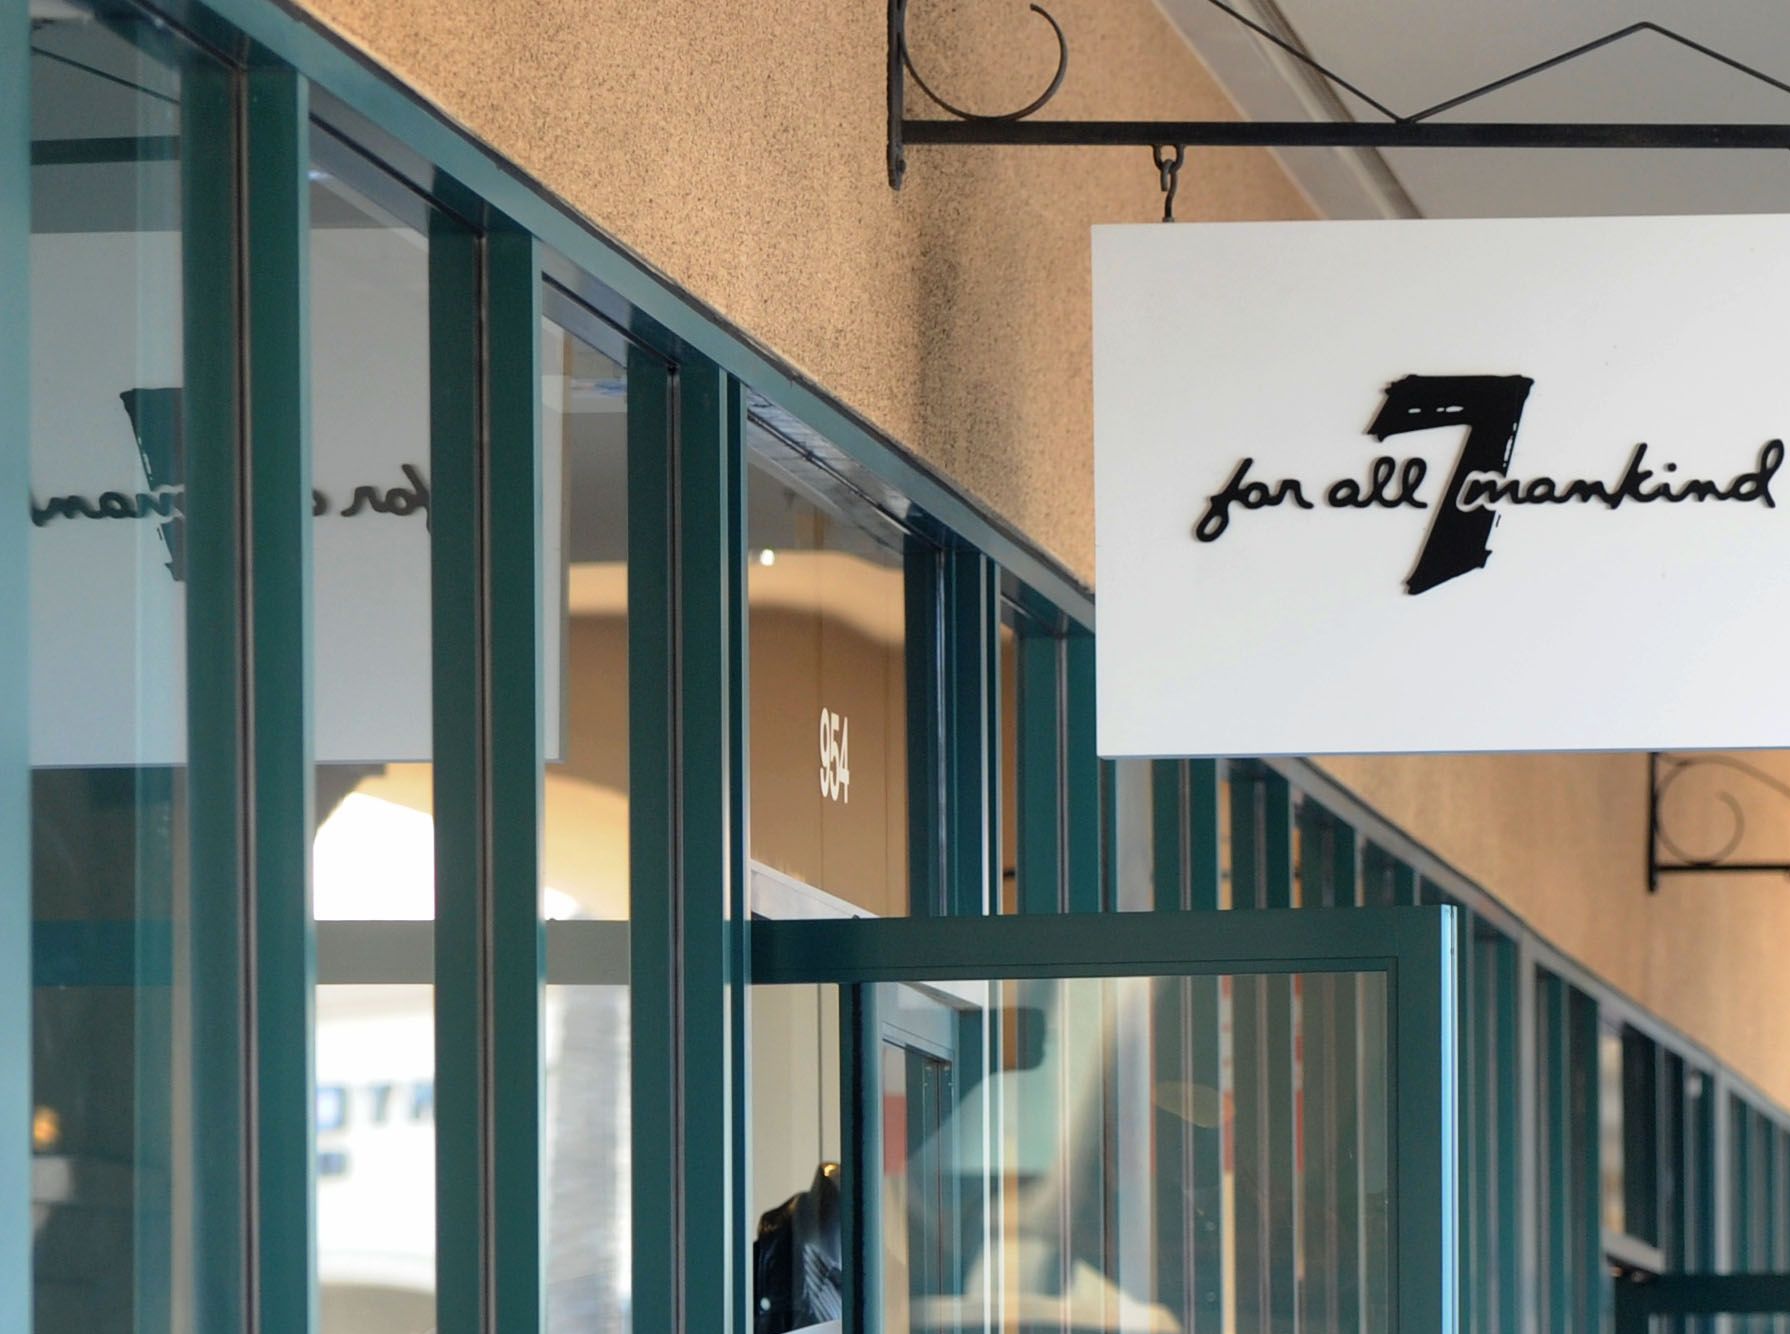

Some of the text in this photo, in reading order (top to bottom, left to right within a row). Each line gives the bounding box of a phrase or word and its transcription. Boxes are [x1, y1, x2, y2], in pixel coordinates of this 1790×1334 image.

[1195, 373, 1785, 595] for all 7 mankind
[819, 707, 850, 804] 954
